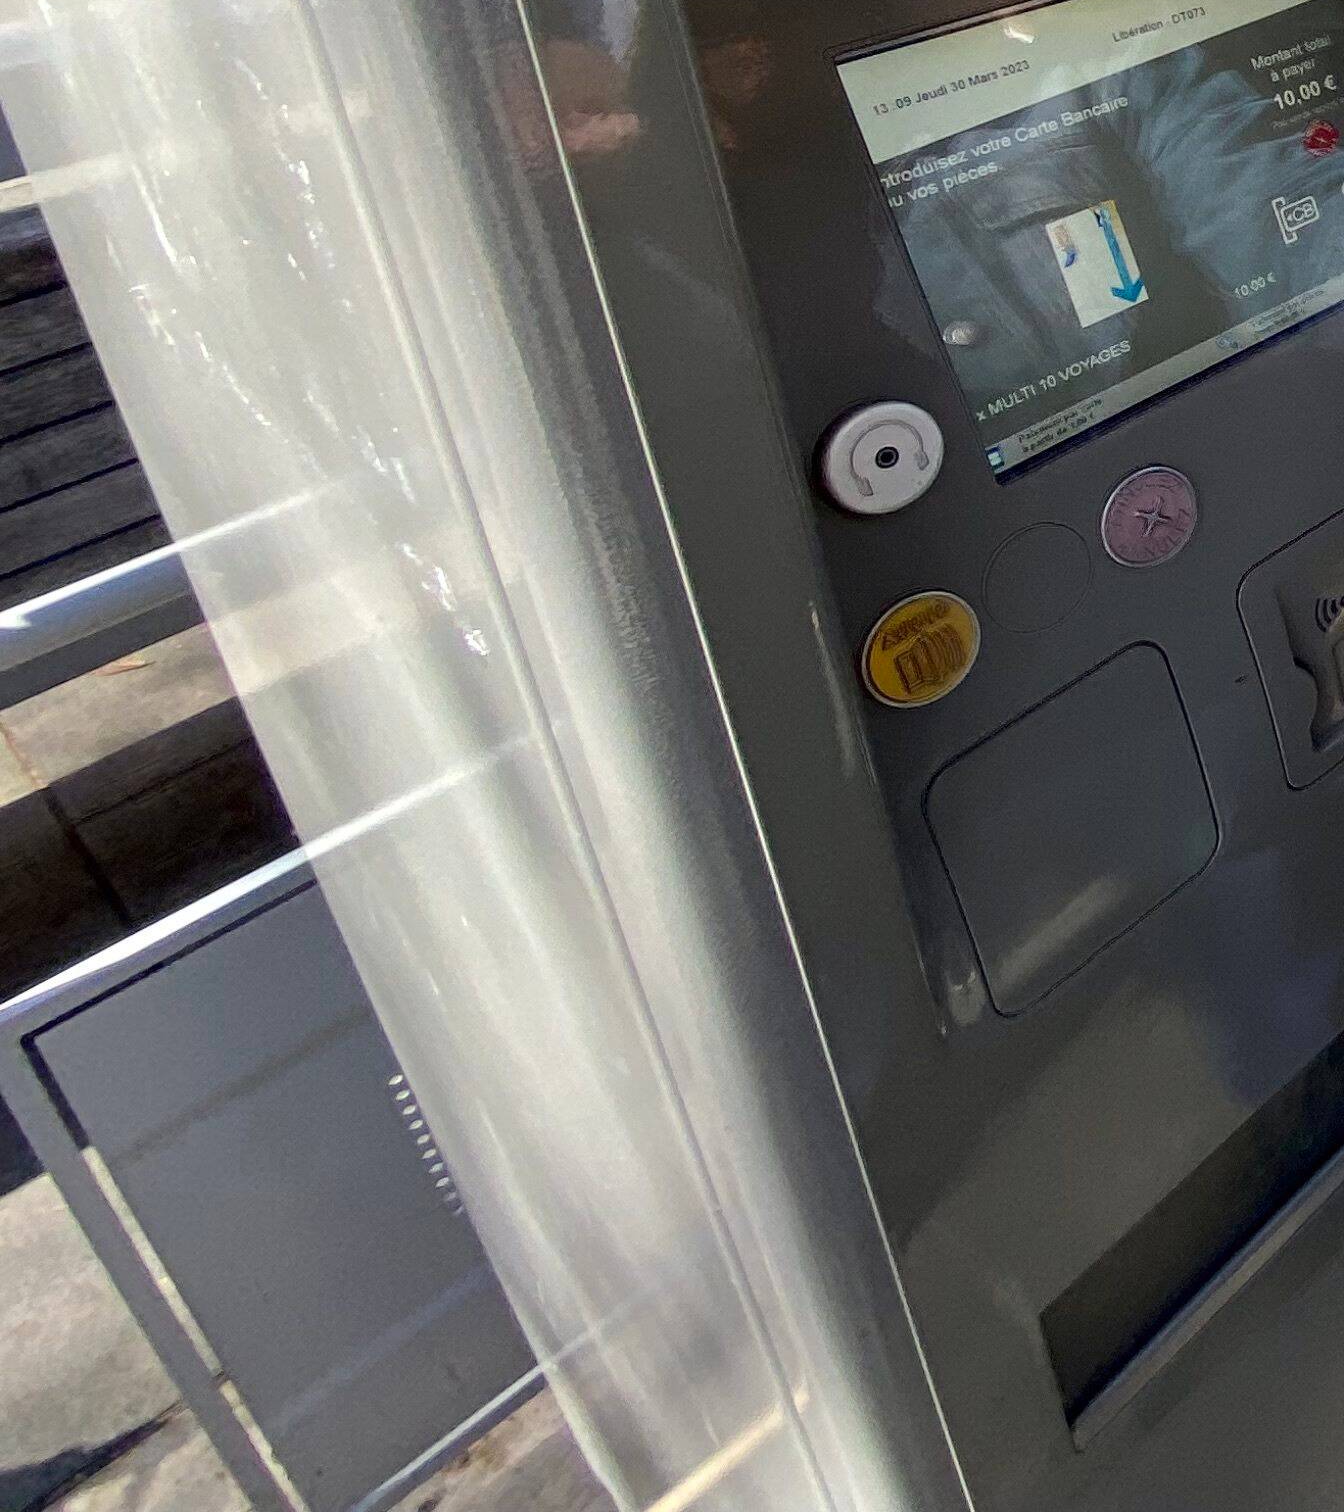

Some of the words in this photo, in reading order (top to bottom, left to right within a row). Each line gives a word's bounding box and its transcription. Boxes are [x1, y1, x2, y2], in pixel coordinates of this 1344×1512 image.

[1112, 19, 1163, 42] Libération
[1251, 41, 1302, 70] Montant
[1271, 67, 1279, 82] à
[1283, 57, 1315, 79] payer
[916, 87, 947, 103] Jeudi
[950, 80, 965, 94] 30
[968, 71, 999, 87] Mars
[1001, 59, 1030, 78] 2023
[1274, 81, 1321, 110] 10,00
[1324, 74, 1337, 91] €
[881, 150, 969, 189] ntroduisez
[972, 136, 1012, 158] votre
[1015, 120, 1059, 143] Carte
[1061, 94, 1129, 126] Bancaire
[907, 182, 939, 201] vos
[1290, 202, 1315, 223] CB
[987, 384, 1037, 417] MULTI
[1038, 374, 1057, 392] 10
[1057, 339, 1132, 382] VOYAGES
